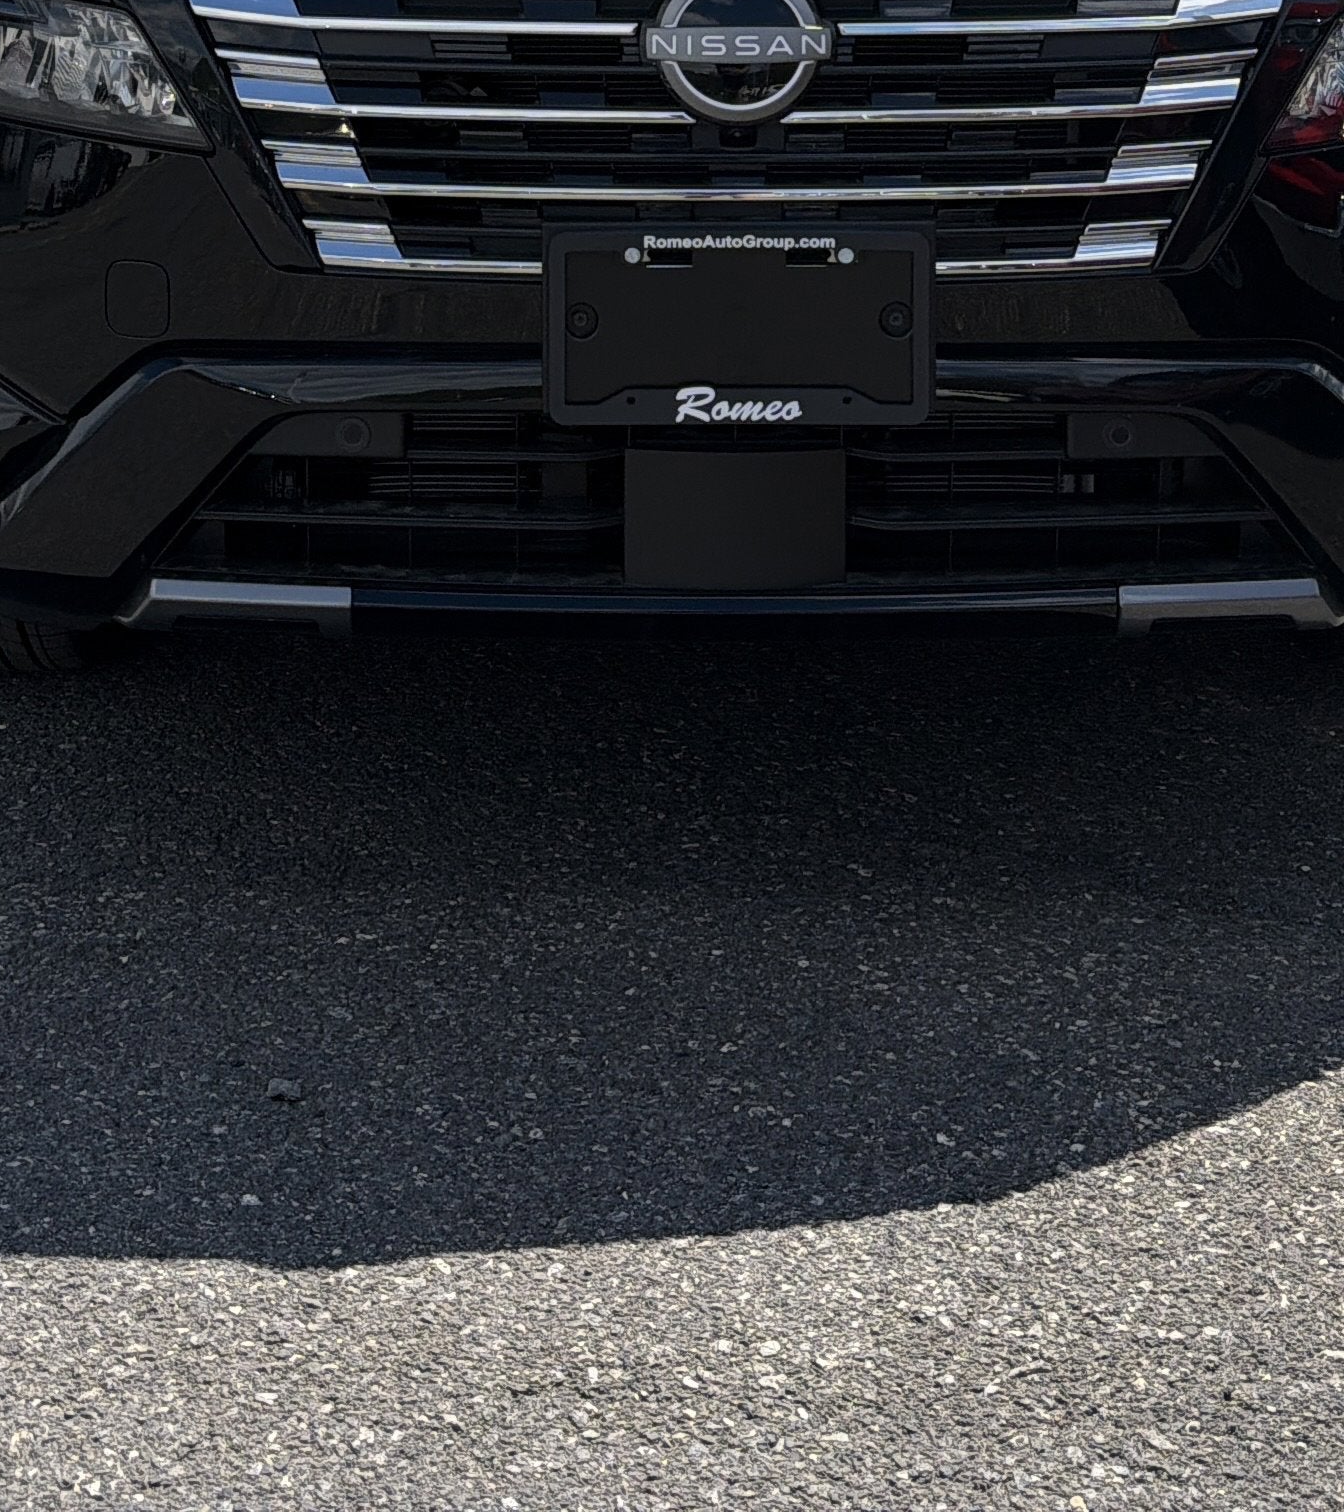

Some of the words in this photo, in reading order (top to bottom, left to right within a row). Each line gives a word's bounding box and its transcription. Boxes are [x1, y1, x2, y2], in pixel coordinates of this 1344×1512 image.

[652, 34, 826, 56] NISSAN
[643, 235, 836, 251] RomeoAutoGroup.com
[675, 386, 803, 424] Romeo
